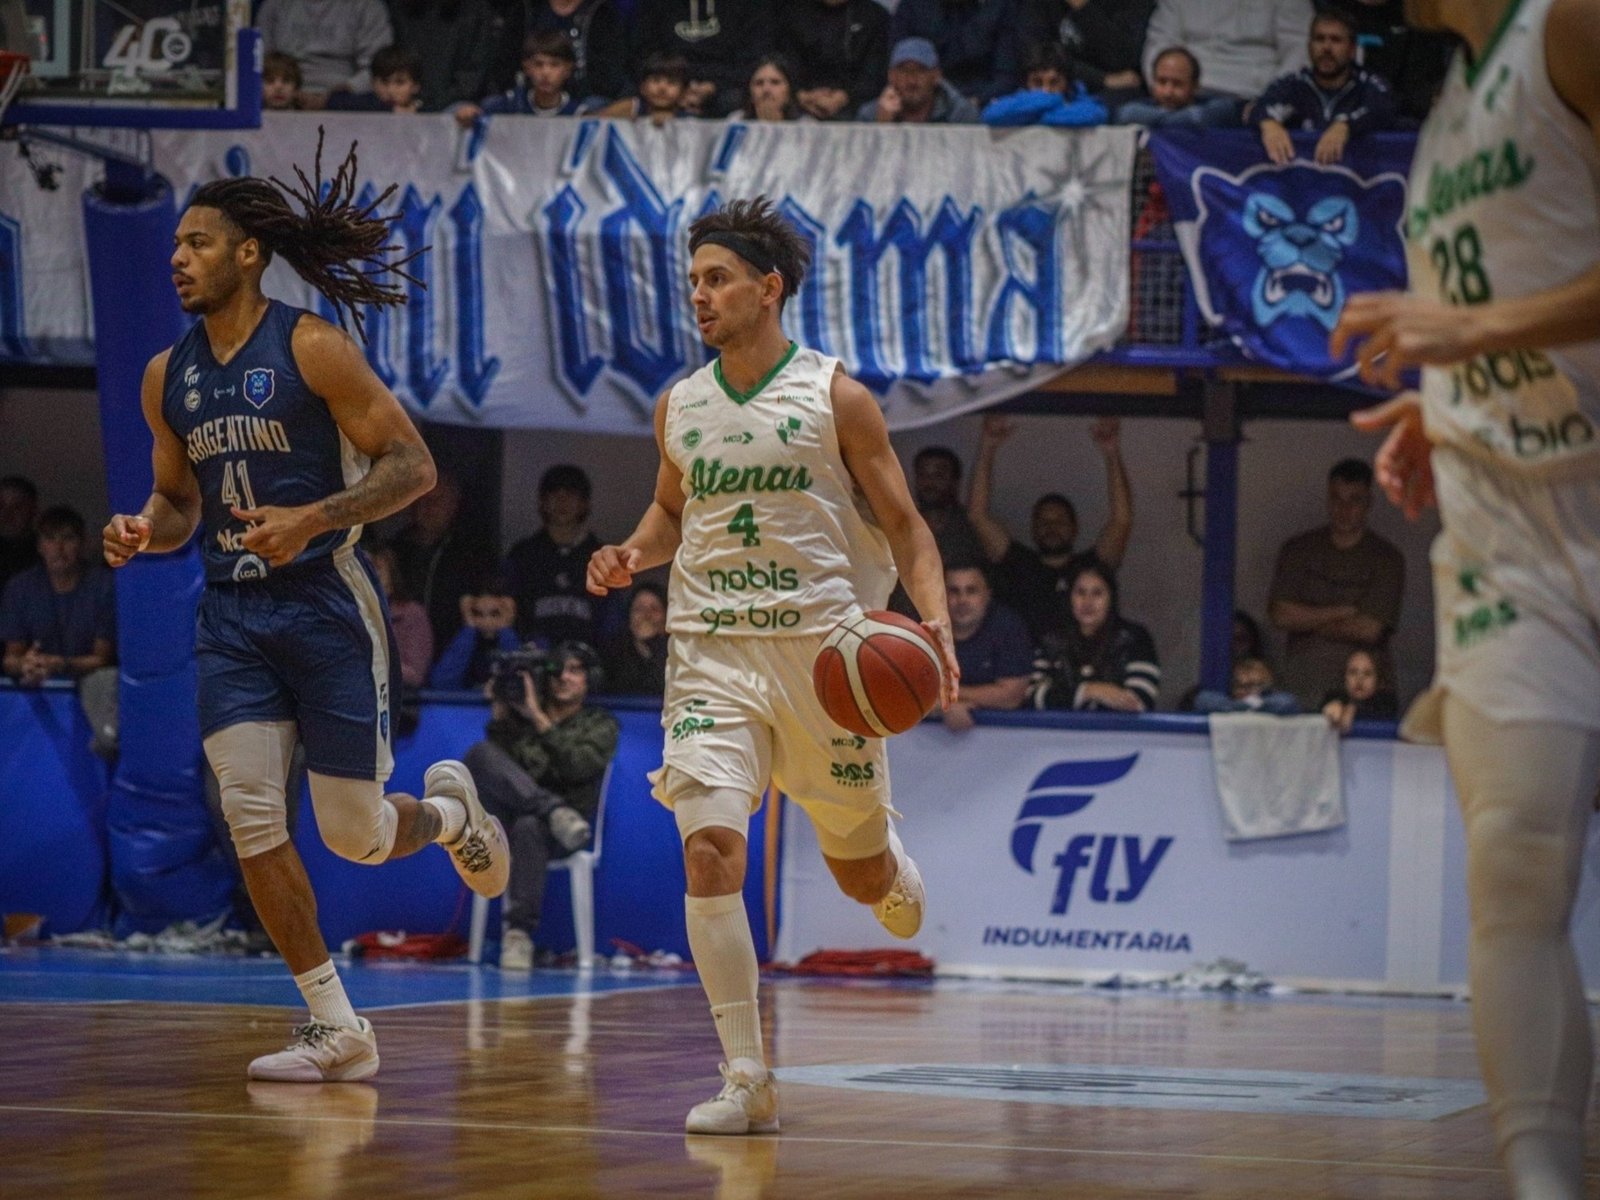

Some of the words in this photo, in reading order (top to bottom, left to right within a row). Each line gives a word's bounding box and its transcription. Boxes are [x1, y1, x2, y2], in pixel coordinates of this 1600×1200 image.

[187, 415, 291, 464] ARGENTINO
[221, 459, 256, 511] 41
[691, 456, 813, 500] Atenas
[727, 503, 761, 547] 4
[707, 560, 799, 592] nobis
[1050, 834, 1174, 915] fly
[982, 925, 1192, 952] INDUMENTARIA
